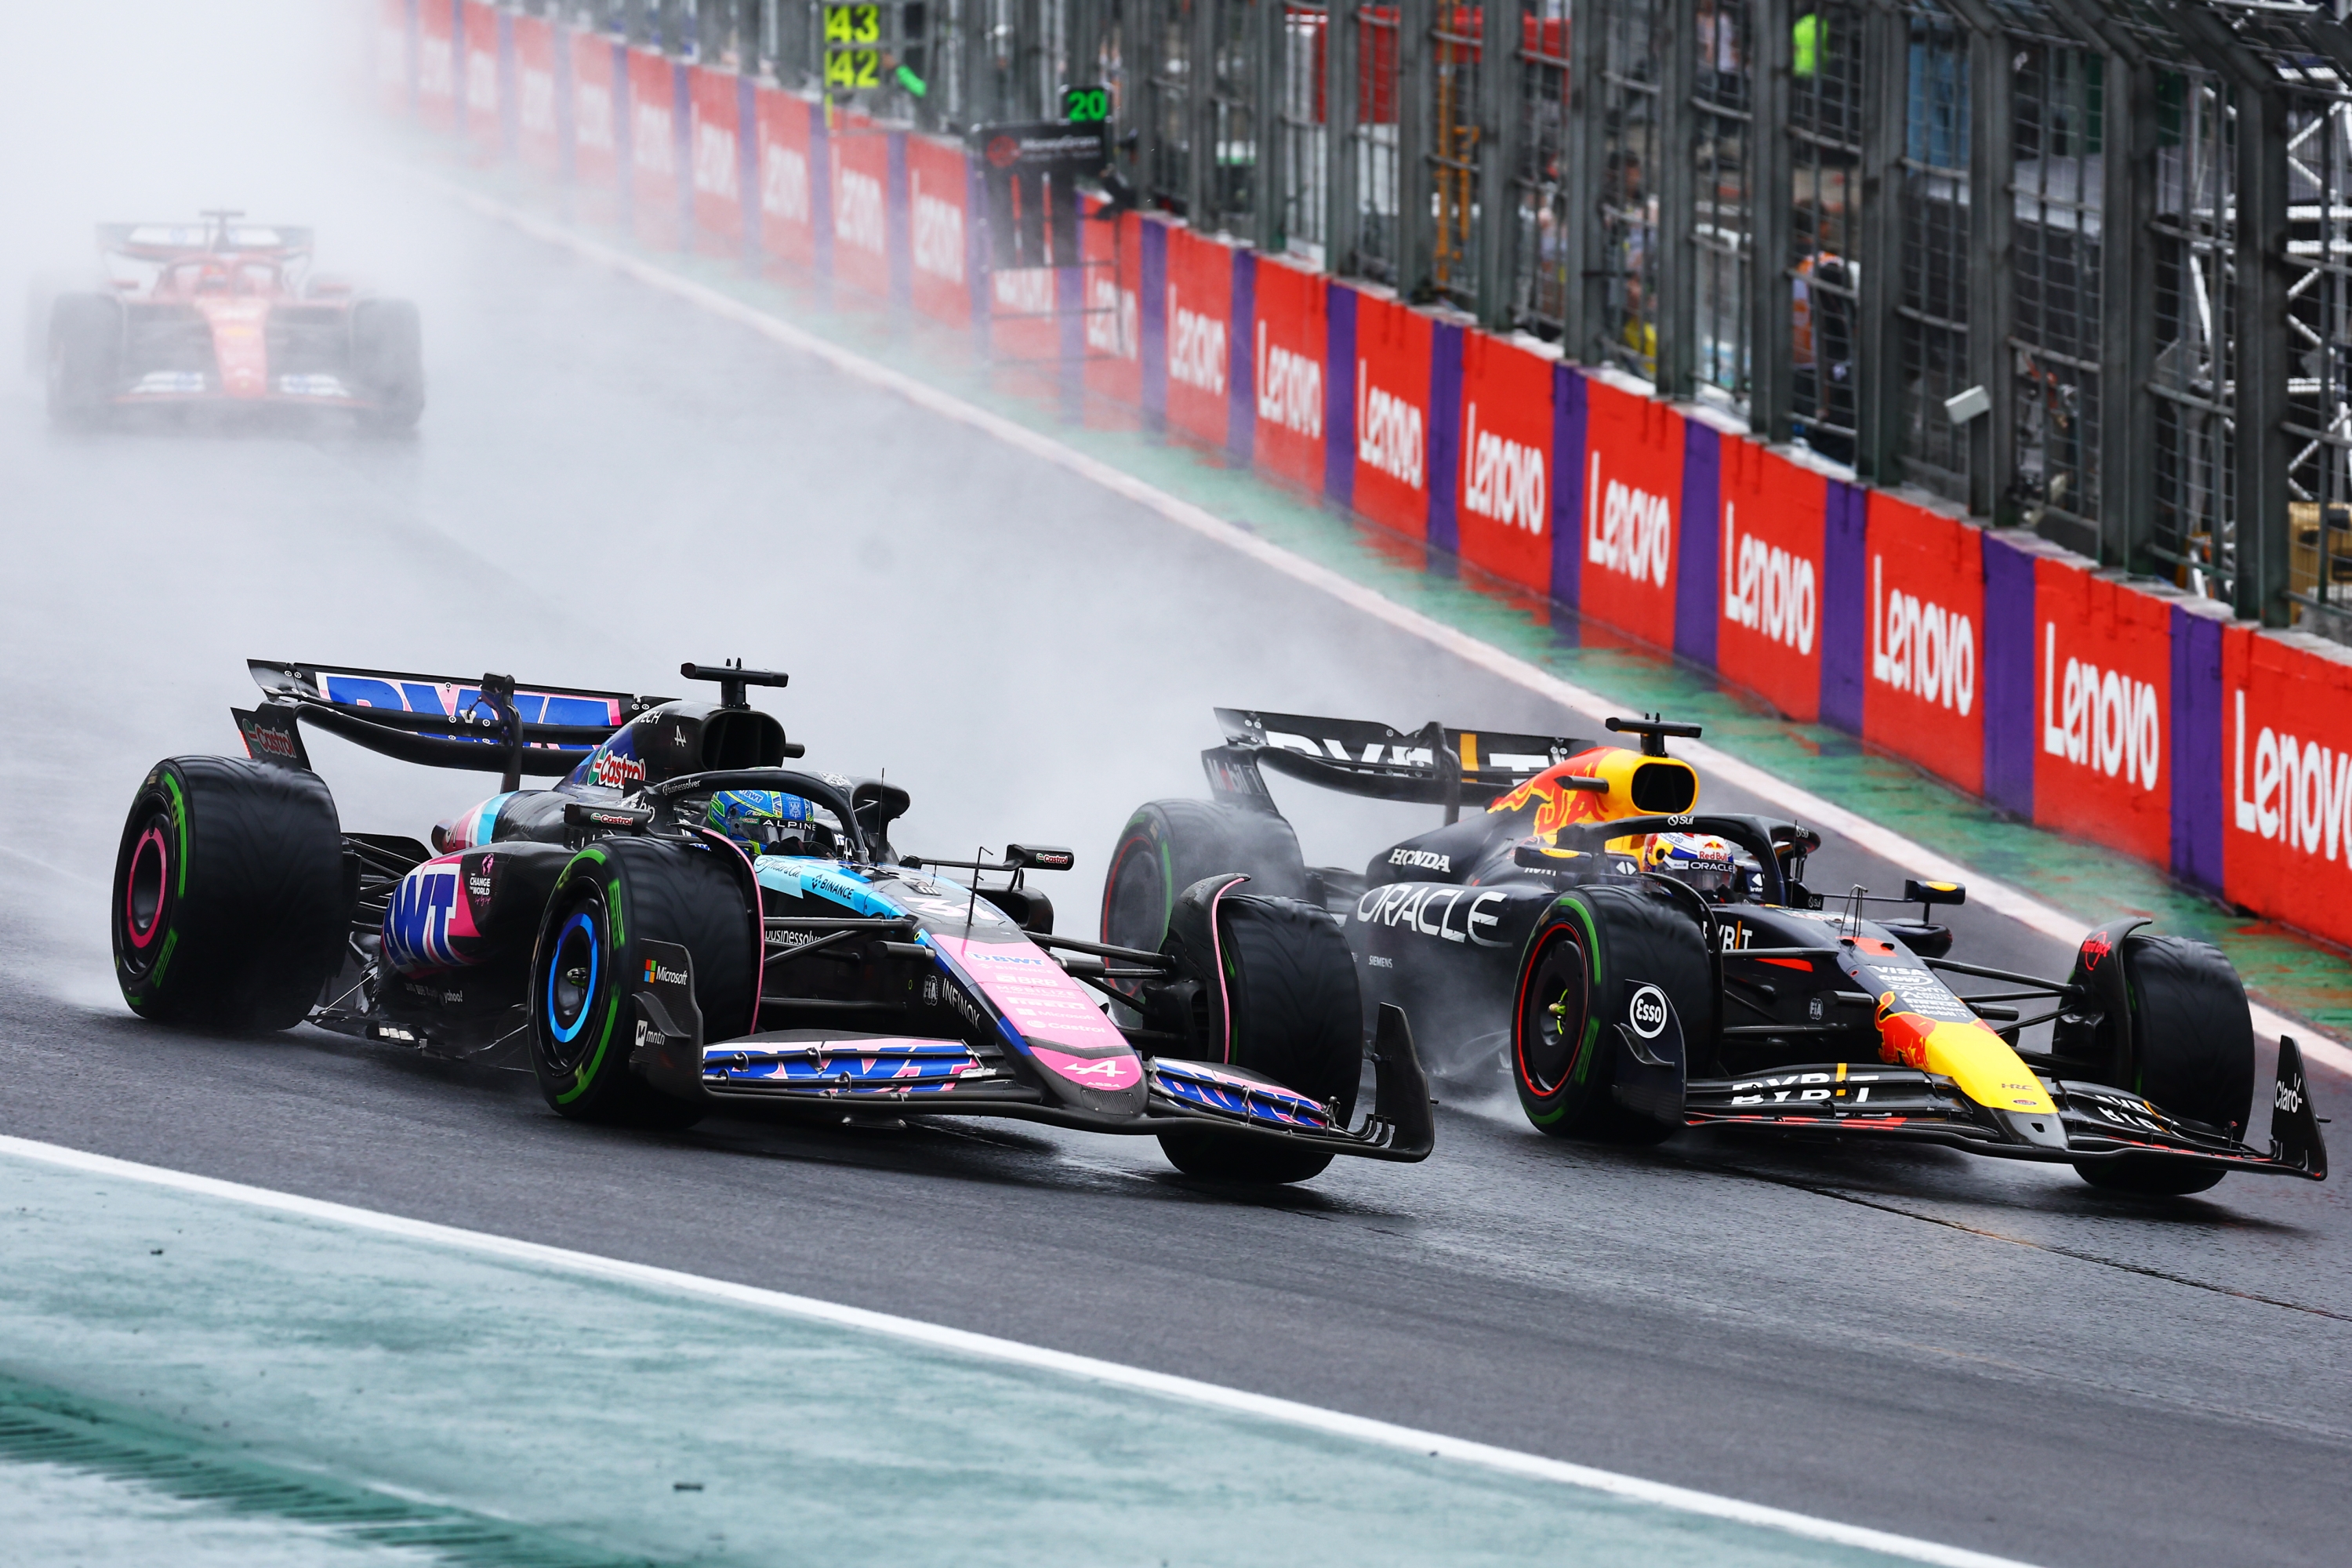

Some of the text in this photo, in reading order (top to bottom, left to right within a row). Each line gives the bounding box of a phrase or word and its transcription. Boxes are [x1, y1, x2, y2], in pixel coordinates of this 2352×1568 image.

[1068, 90, 1107, 122] 20
[1258, 320, 1322, 440] Lenovo
[1359, 359, 1423, 488] Lenovo
[1465, 402, 1545, 535] Lenovo
[1588, 451, 1671, 588] Lenovo
[1726, 501, 1816, 655] Lenovo
[1873, 554, 1975, 717] Lenovo
[2045, 622, 2160, 791] Lenovo
[255, 723, 297, 759] Castrol
[598, 750, 646, 789] Castrol
[1207, 757, 1252, 795] Mobil
[666, 779, 701, 794] businessolver
[601, 815, 633, 826] Castrol
[762, 818, 816, 831] ALPINE
[1679, 816, 1694, 825] Sui
[1044, 854, 1068, 865] Castrol
[1388, 848, 1451, 873] HONDA
[1699, 851, 1728, 861] Red Bull
[1690, 862, 1734, 873] ORACLE
[470, 877, 491, 887] CHANGE
[473, 887, 490, 895] WORLD
[820, 878, 855, 900] BINANCE
[902, 896, 1001, 921] 31
[1357, 884, 1514, 949] ORACLE
[991, 955, 1045, 967] BWT
[994, 965, 1055, 975] BINANCE
[1369, 954, 1393, 969] SIEMENS
[655, 965, 688, 985] Microsoft
[1867, 965, 1927, 977] VISA
[1878, 975, 1921, 983] CDW
[1017, 976, 1058, 987] BRB
[1888, 984, 1946, 994] zoom
[443, 989, 463, 1004] yahoo!
[942, 978, 982, 1033] INFINOX
[1036, 1010, 1096, 1021] Microsoft
[1635, 998, 1662, 1025] Esso
[646, 1029, 666, 1047] mntn
[2274, 1080, 2299, 1113] Claro
